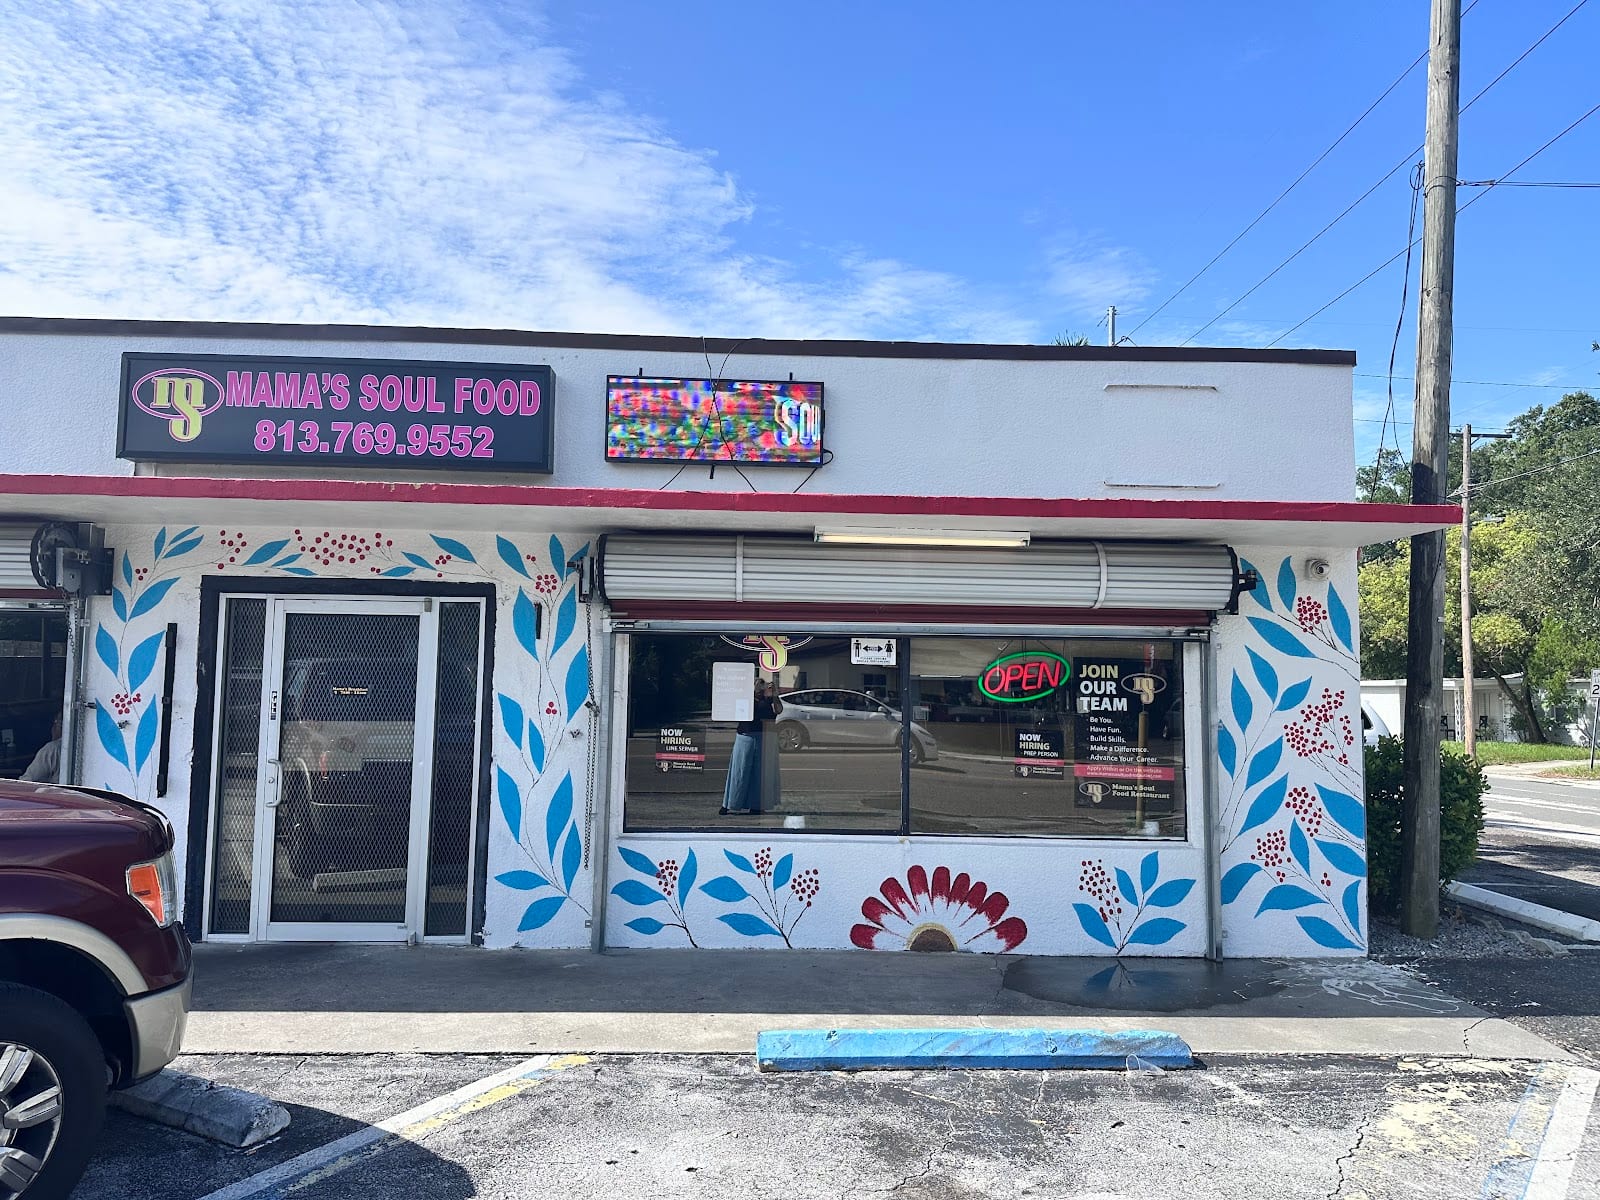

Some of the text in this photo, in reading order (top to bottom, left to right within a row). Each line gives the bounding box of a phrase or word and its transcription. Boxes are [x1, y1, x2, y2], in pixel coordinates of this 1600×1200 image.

[226, 371, 541, 416] MAMA'S SOUL FOOD
[254, 420, 494, 458] 813.769.9552
[1079, 664, 1118, 679] JOIN
[984, 660, 1061, 694] OPEN
[1079, 680, 1117, 695] OUR
[1079, 696, 1128, 712] TEAM
[660, 728, 683, 737] NOW
[1107, 726, 1122, 734] Fun.
[660, 737, 692, 745] HIRING
[1019, 733, 1041, 741] NOW
[1019, 741, 1050, 750] HIRING
[1114, 745, 1150, 753] Difference.
[1089, 754, 1118, 762] Advance
[1111, 783, 1155, 792] Mama's Soul
[1130, 791, 1170, 799] Restaurant
